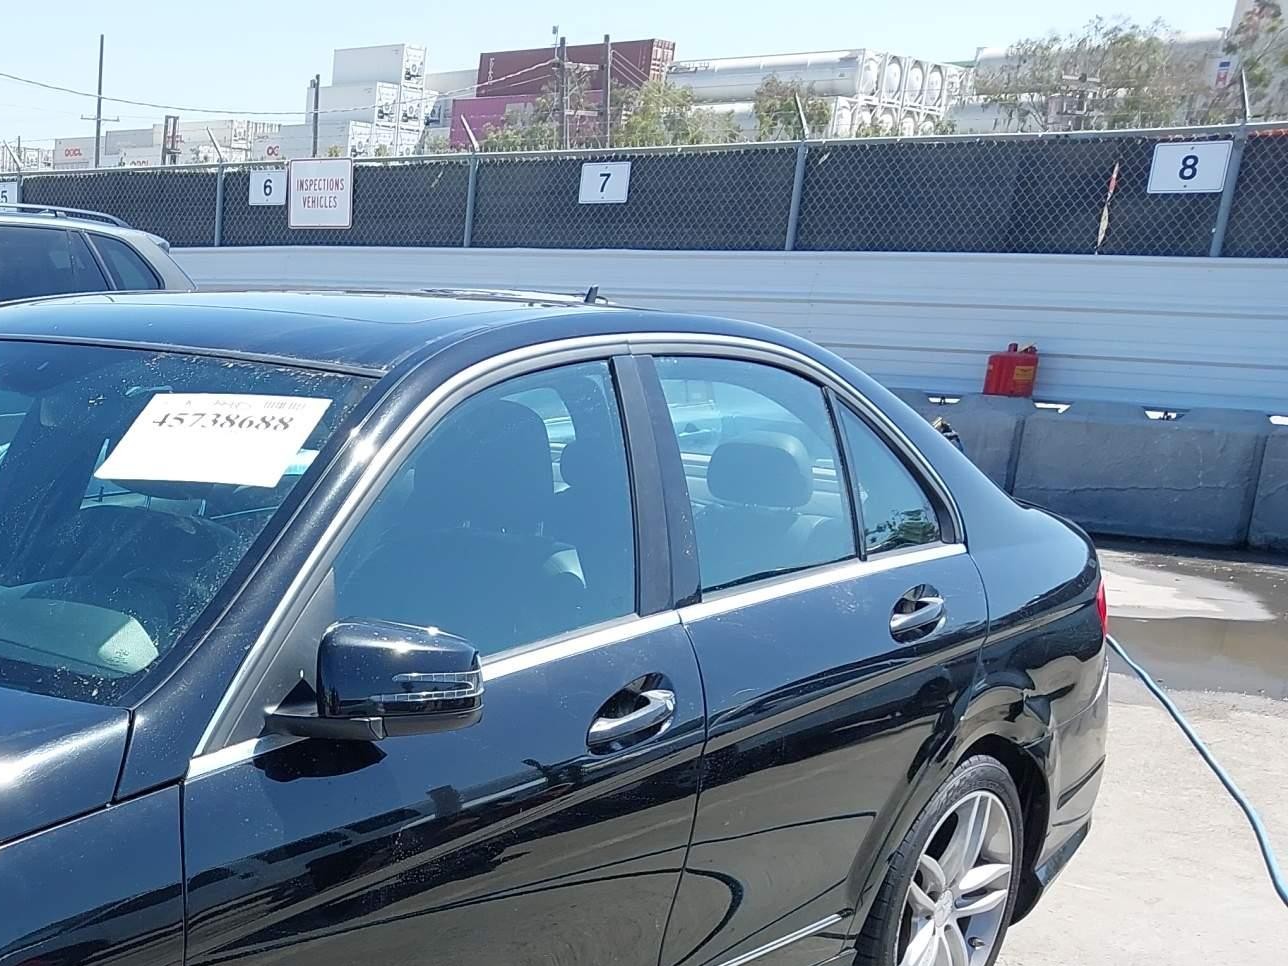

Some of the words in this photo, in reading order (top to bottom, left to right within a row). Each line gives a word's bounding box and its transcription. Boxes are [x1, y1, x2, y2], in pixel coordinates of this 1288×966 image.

[1178, 154, 1198, 182] 8
[263, 178, 273, 197] 6
[295, 177, 345, 192] INSPECTIONS
[598, 171, 611, 194] 7
[0, 190, 8, 204] 5
[302, 195, 338, 209] VEHICLES
[152, 412, 295, 432] 45738688
